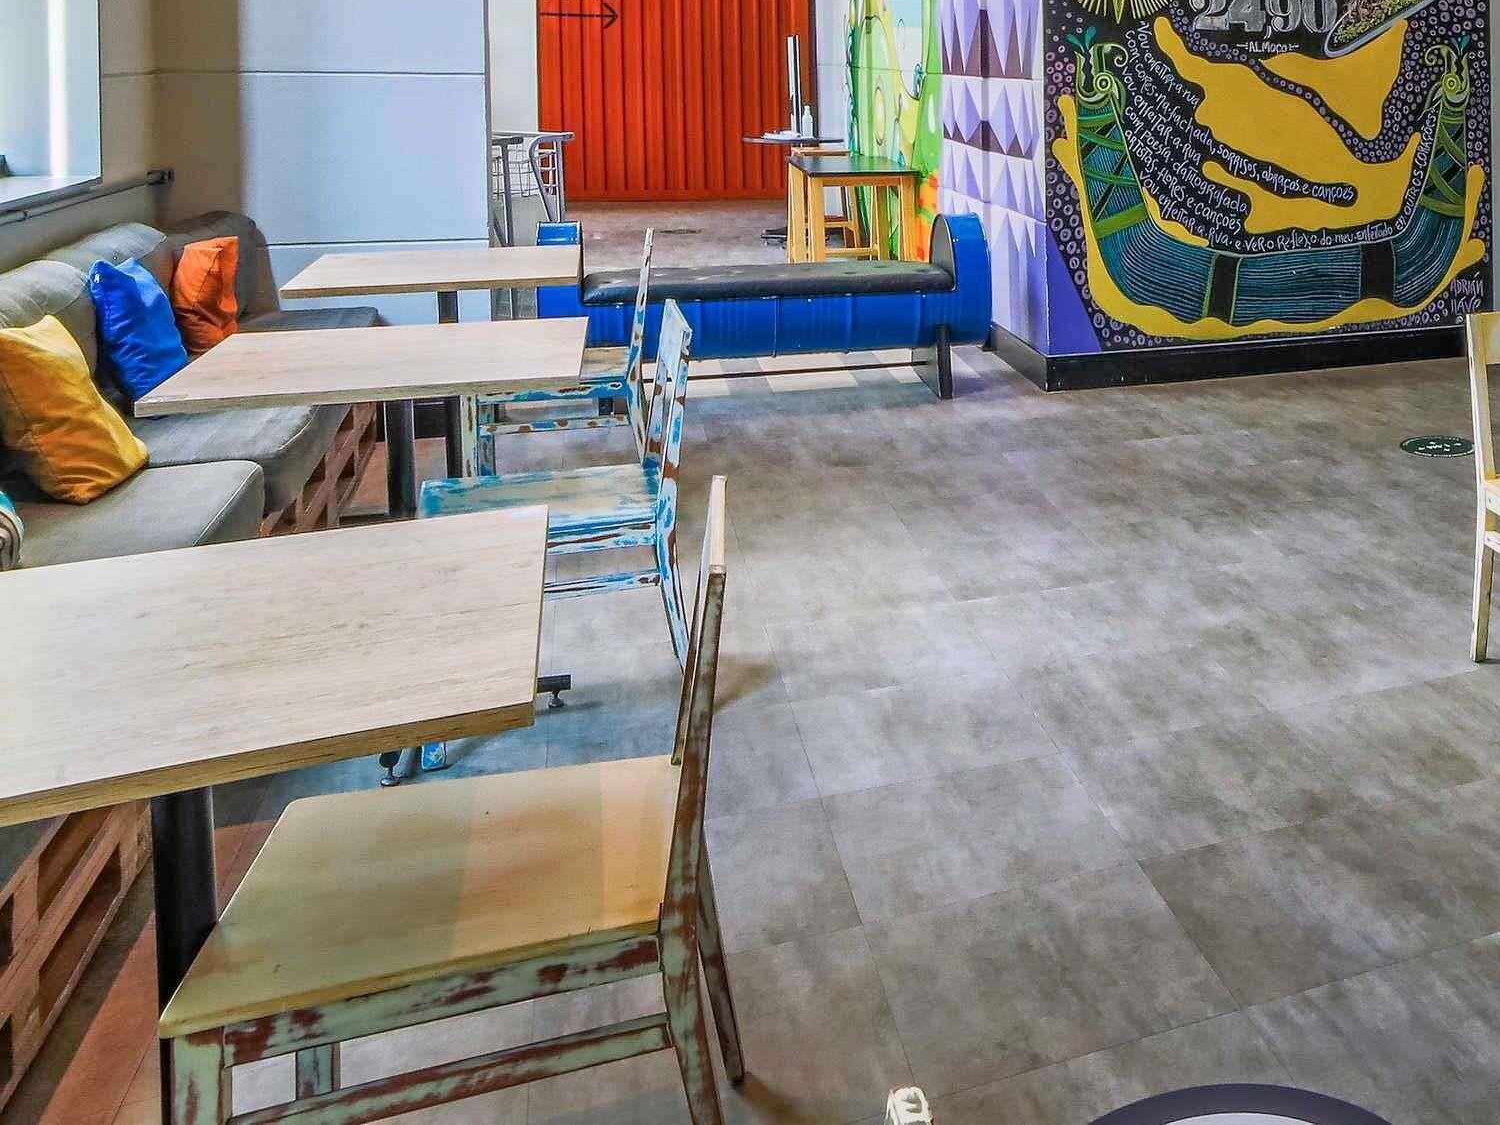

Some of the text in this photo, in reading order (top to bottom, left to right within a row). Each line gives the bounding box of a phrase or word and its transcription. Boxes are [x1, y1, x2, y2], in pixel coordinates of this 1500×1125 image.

[1137, 21, 1152, 49] Vou
[1125, 30, 1141, 63] com
[1303, 183, 1311, 194] e
[1125, 106, 1145, 134] com
[1267, 240, 1275, 250] o
[1319, 229, 1333, 245] do
